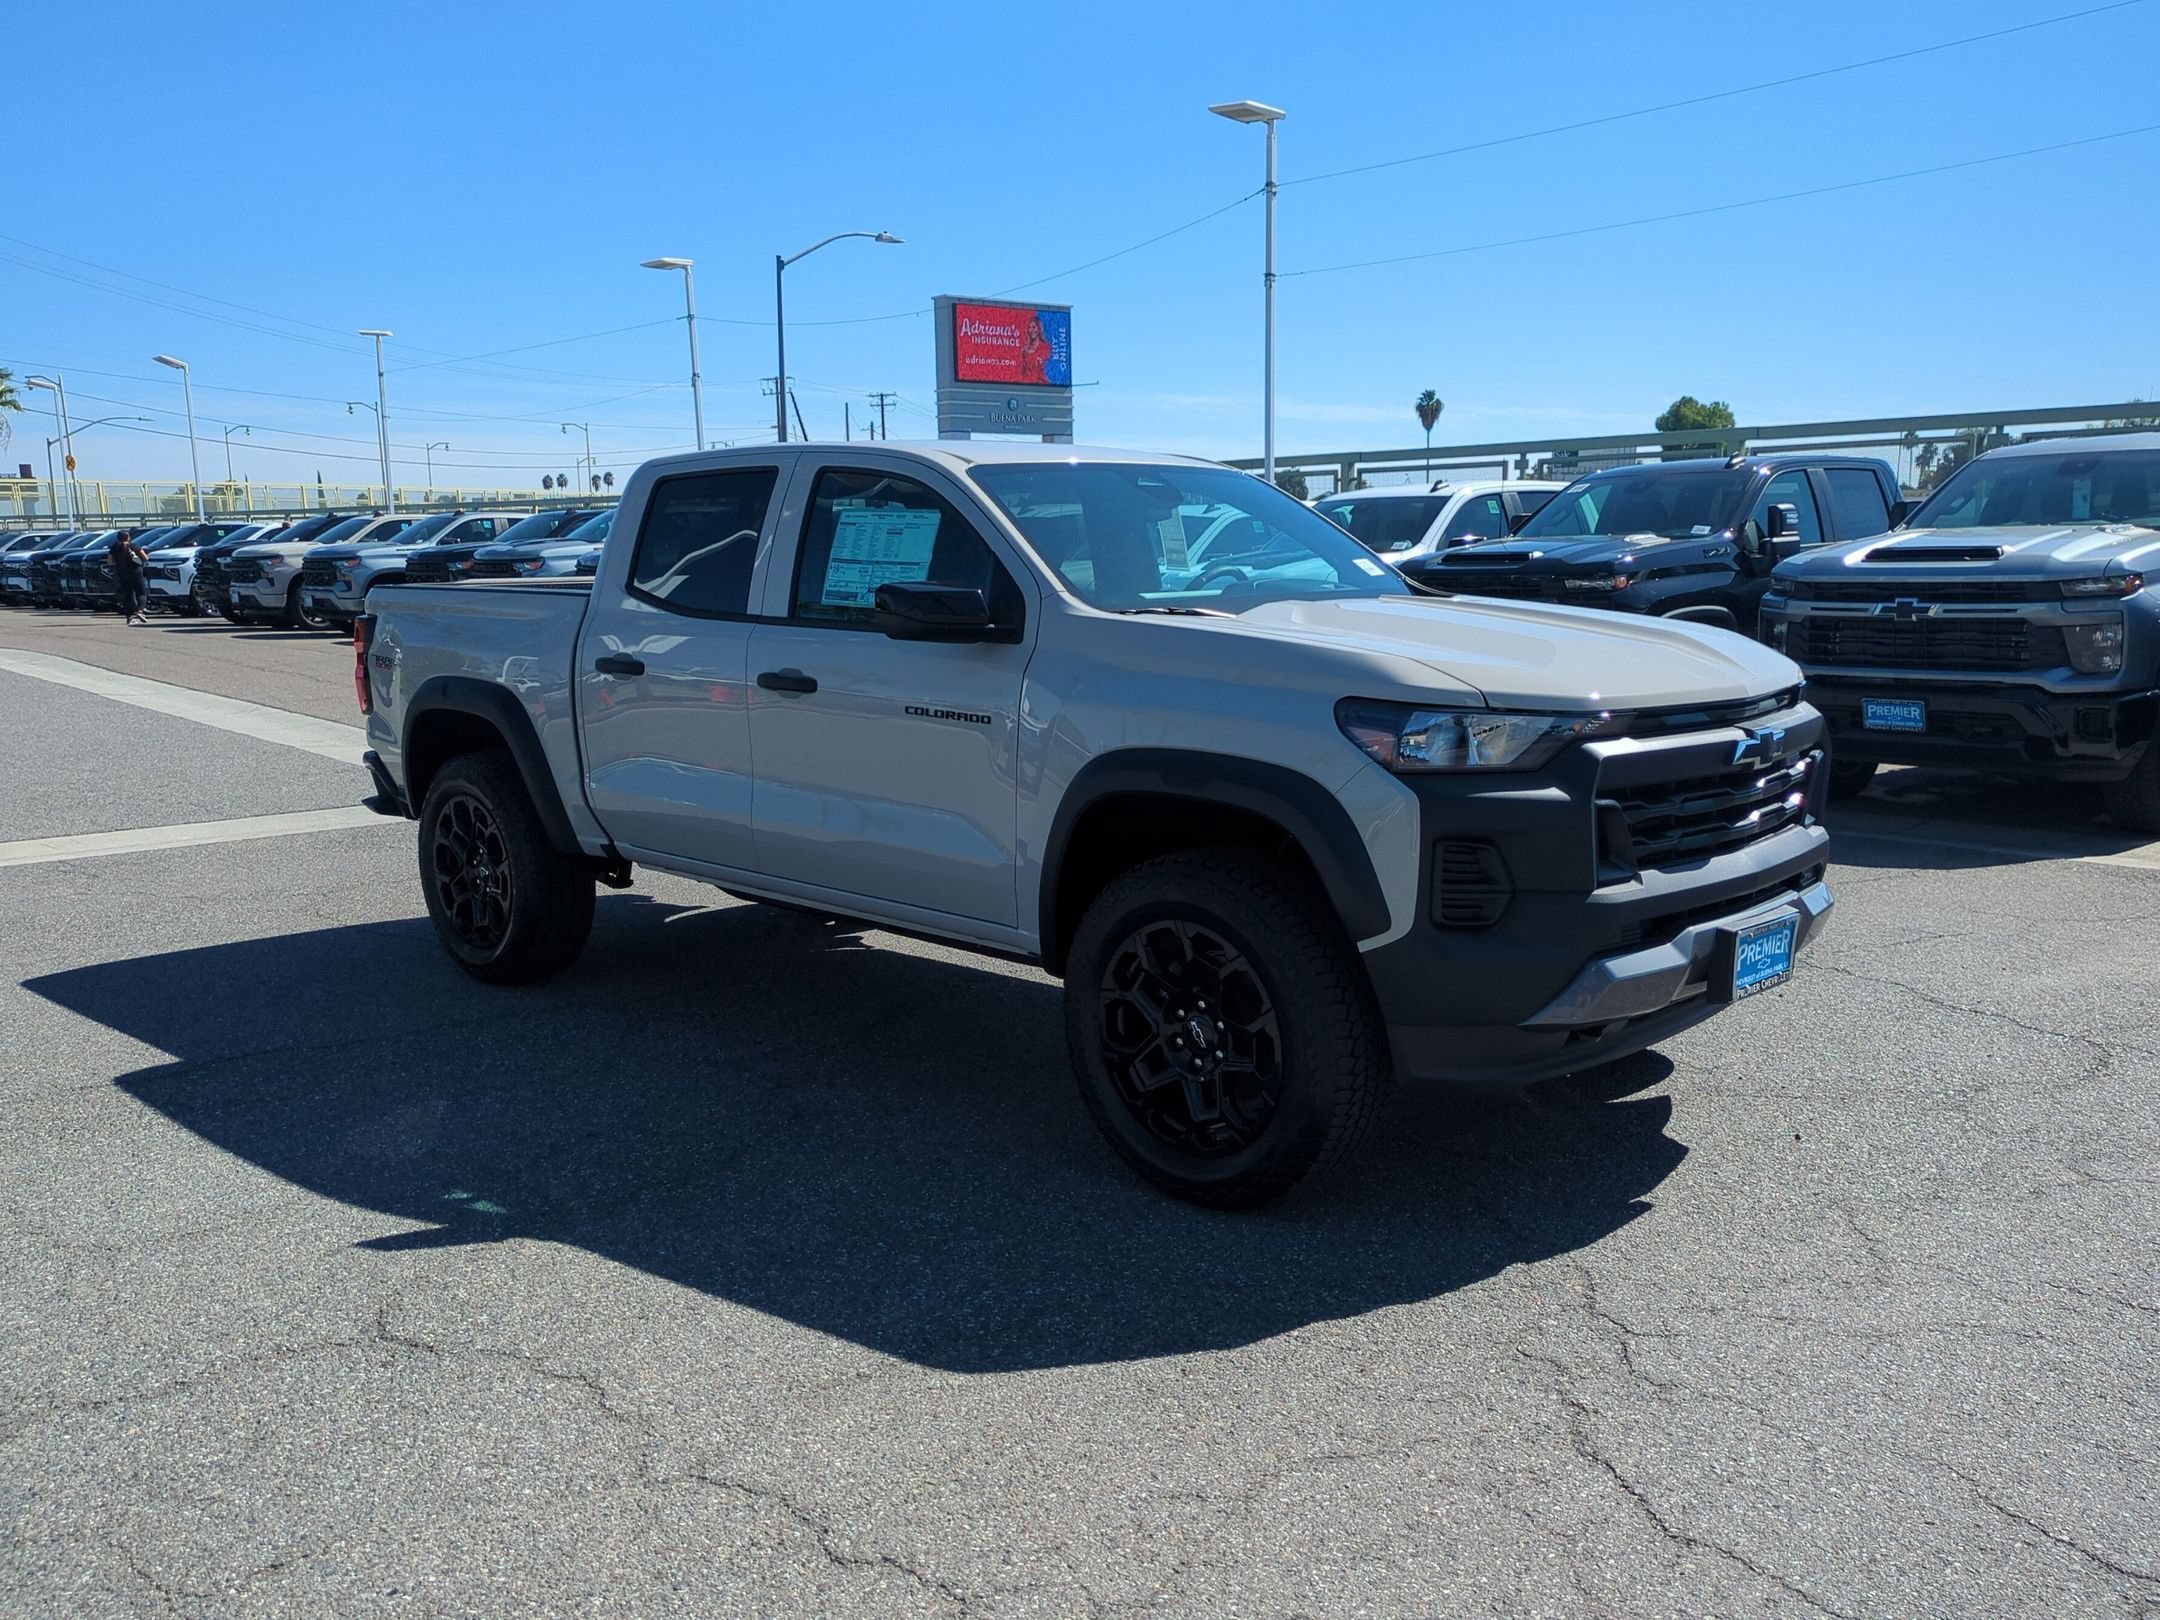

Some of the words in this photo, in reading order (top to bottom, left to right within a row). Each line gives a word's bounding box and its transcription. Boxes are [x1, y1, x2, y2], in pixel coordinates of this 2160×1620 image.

[960, 318, 1020, 337] Adriana's
[971, 335, 1020, 347] INSURANCE
[1051, 336, 1059, 360] BUY
[1058, 327, 1067, 372] ONLINE
[965, 354, 1017, 367] adrianas.com
[991, 412, 1016, 423] BUENA
[1017, 413, 1036, 424] PARK
[904, 705, 992, 725] COLORADO
[1867, 704, 1921, 720] PREMIER
[1737, 930, 1790, 971] PREMIER
